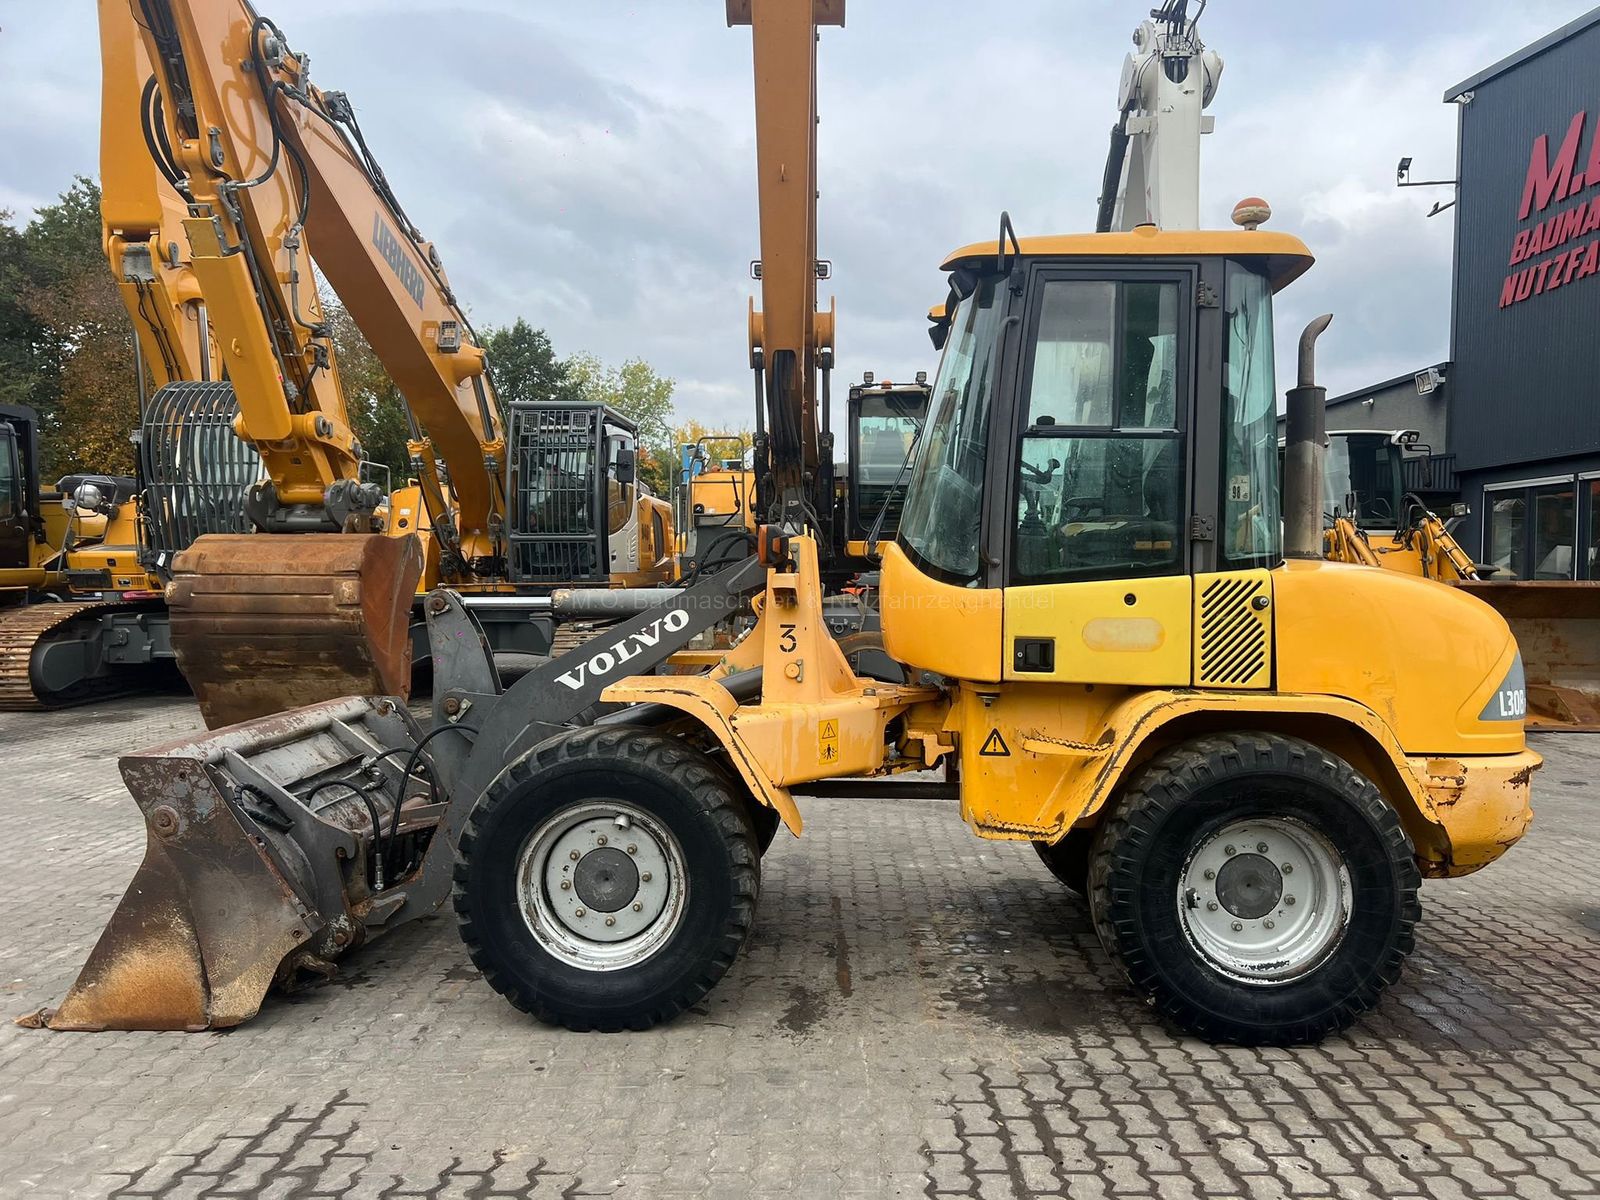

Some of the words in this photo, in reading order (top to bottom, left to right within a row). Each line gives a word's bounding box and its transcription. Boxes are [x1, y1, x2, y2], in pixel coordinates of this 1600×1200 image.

[1517, 108, 1600, 222] M.
[372, 209, 425, 312] LIEBHERR
[553, 609, 690, 690] VOLVO
[779, 623, 797, 653] 3
